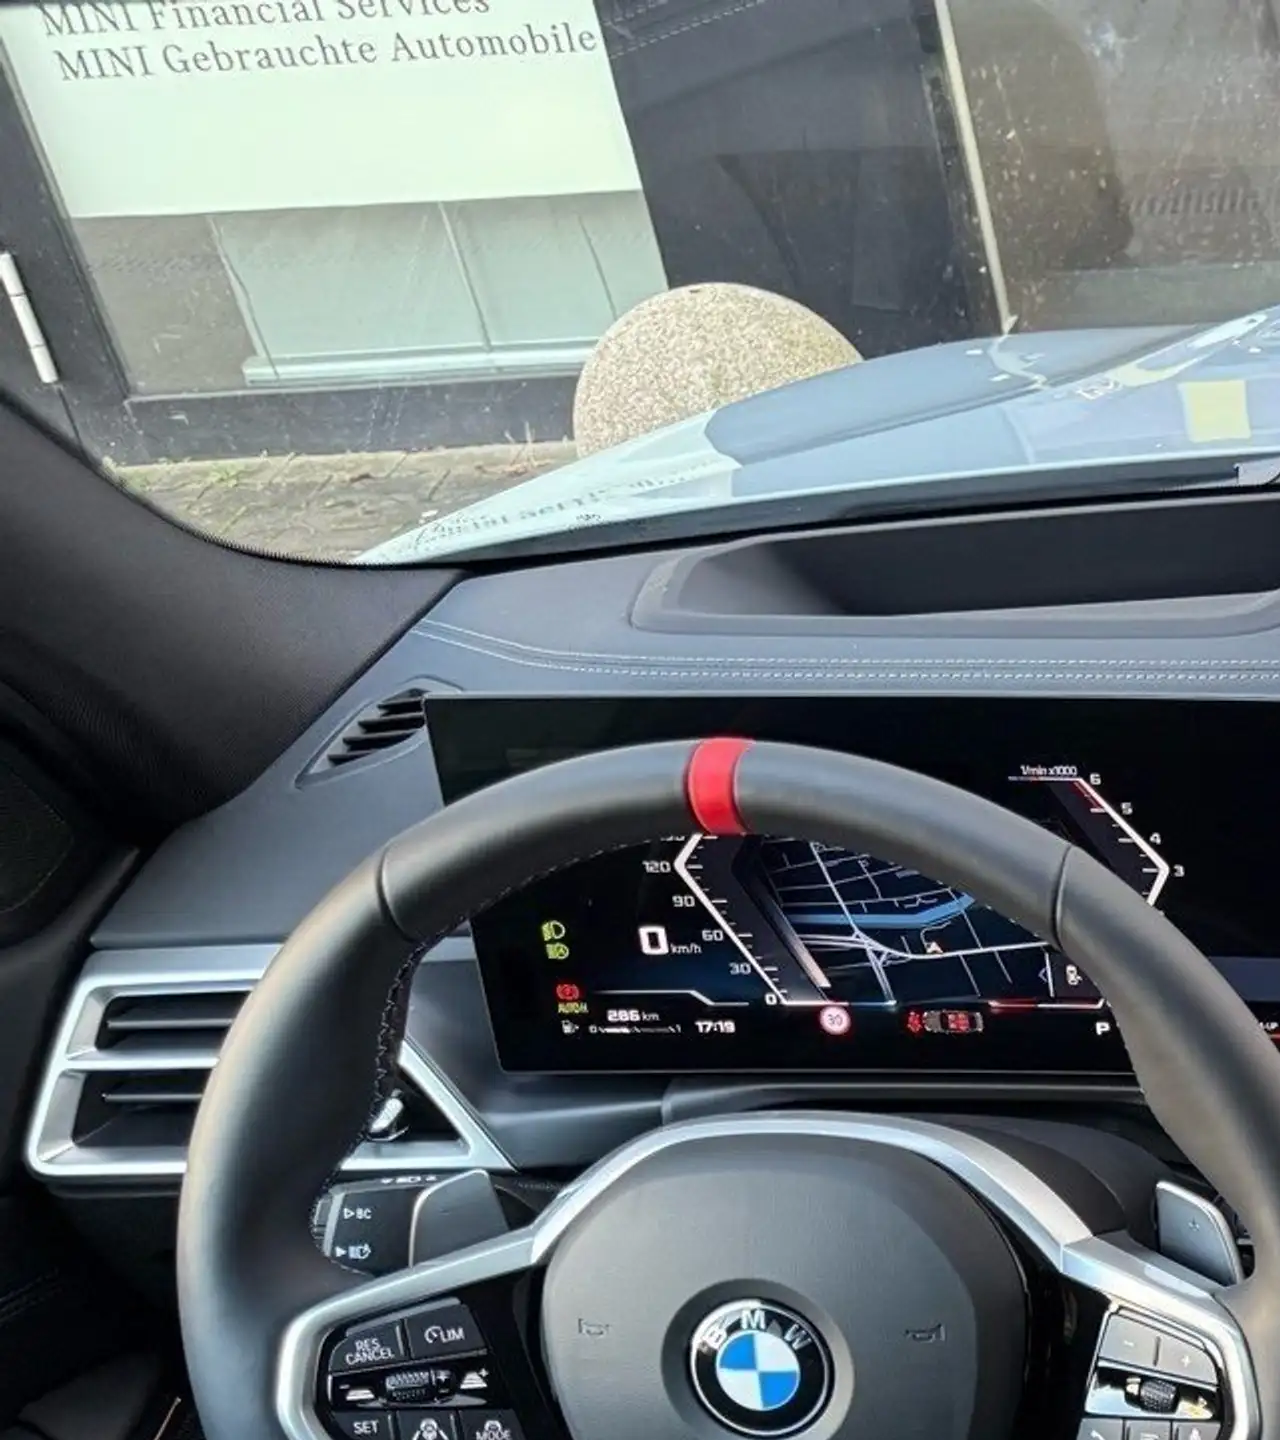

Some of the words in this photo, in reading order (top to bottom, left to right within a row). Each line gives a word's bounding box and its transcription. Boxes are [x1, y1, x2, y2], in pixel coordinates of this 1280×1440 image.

[43, 0, 138, 36] MINI
[150, 0, 324, 30] Financial
[338, 0, 489, 20] Services
[56, 46, 154, 81] MINI
[163, 36, 378, 75] Gebrauchte
[391, 23, 597, 62] Automobile
[1089, 773, 1101, 785] 6
[1120, 802, 1133, 815] 5
[1149, 832, 1162, 845] 4
[642, 861, 671, 873] 120
[1173, 864, 1185, 877] 3
[672, 895, 696, 907] 90
[638, 926, 669, 955] 0
[671, 943, 702, 954] km/h
[702, 929, 724, 941] 60
[729, 963, 751, 975] 30
[765, 993, 777, 1005] 0
[607, 1009, 640, 1022] 286
[641, 1012, 659, 1021] km
[827, 1013, 844, 1028] 30
[695, 1020, 736, 1034] 17:19
[1096, 1022, 1110, 1035] P
[700, 1307, 813, 1352] BMW
[355, 1337, 381, 1351] RES
[345, 1347, 396, 1366] CANCEL
[353, 1420, 380, 1435] SET
